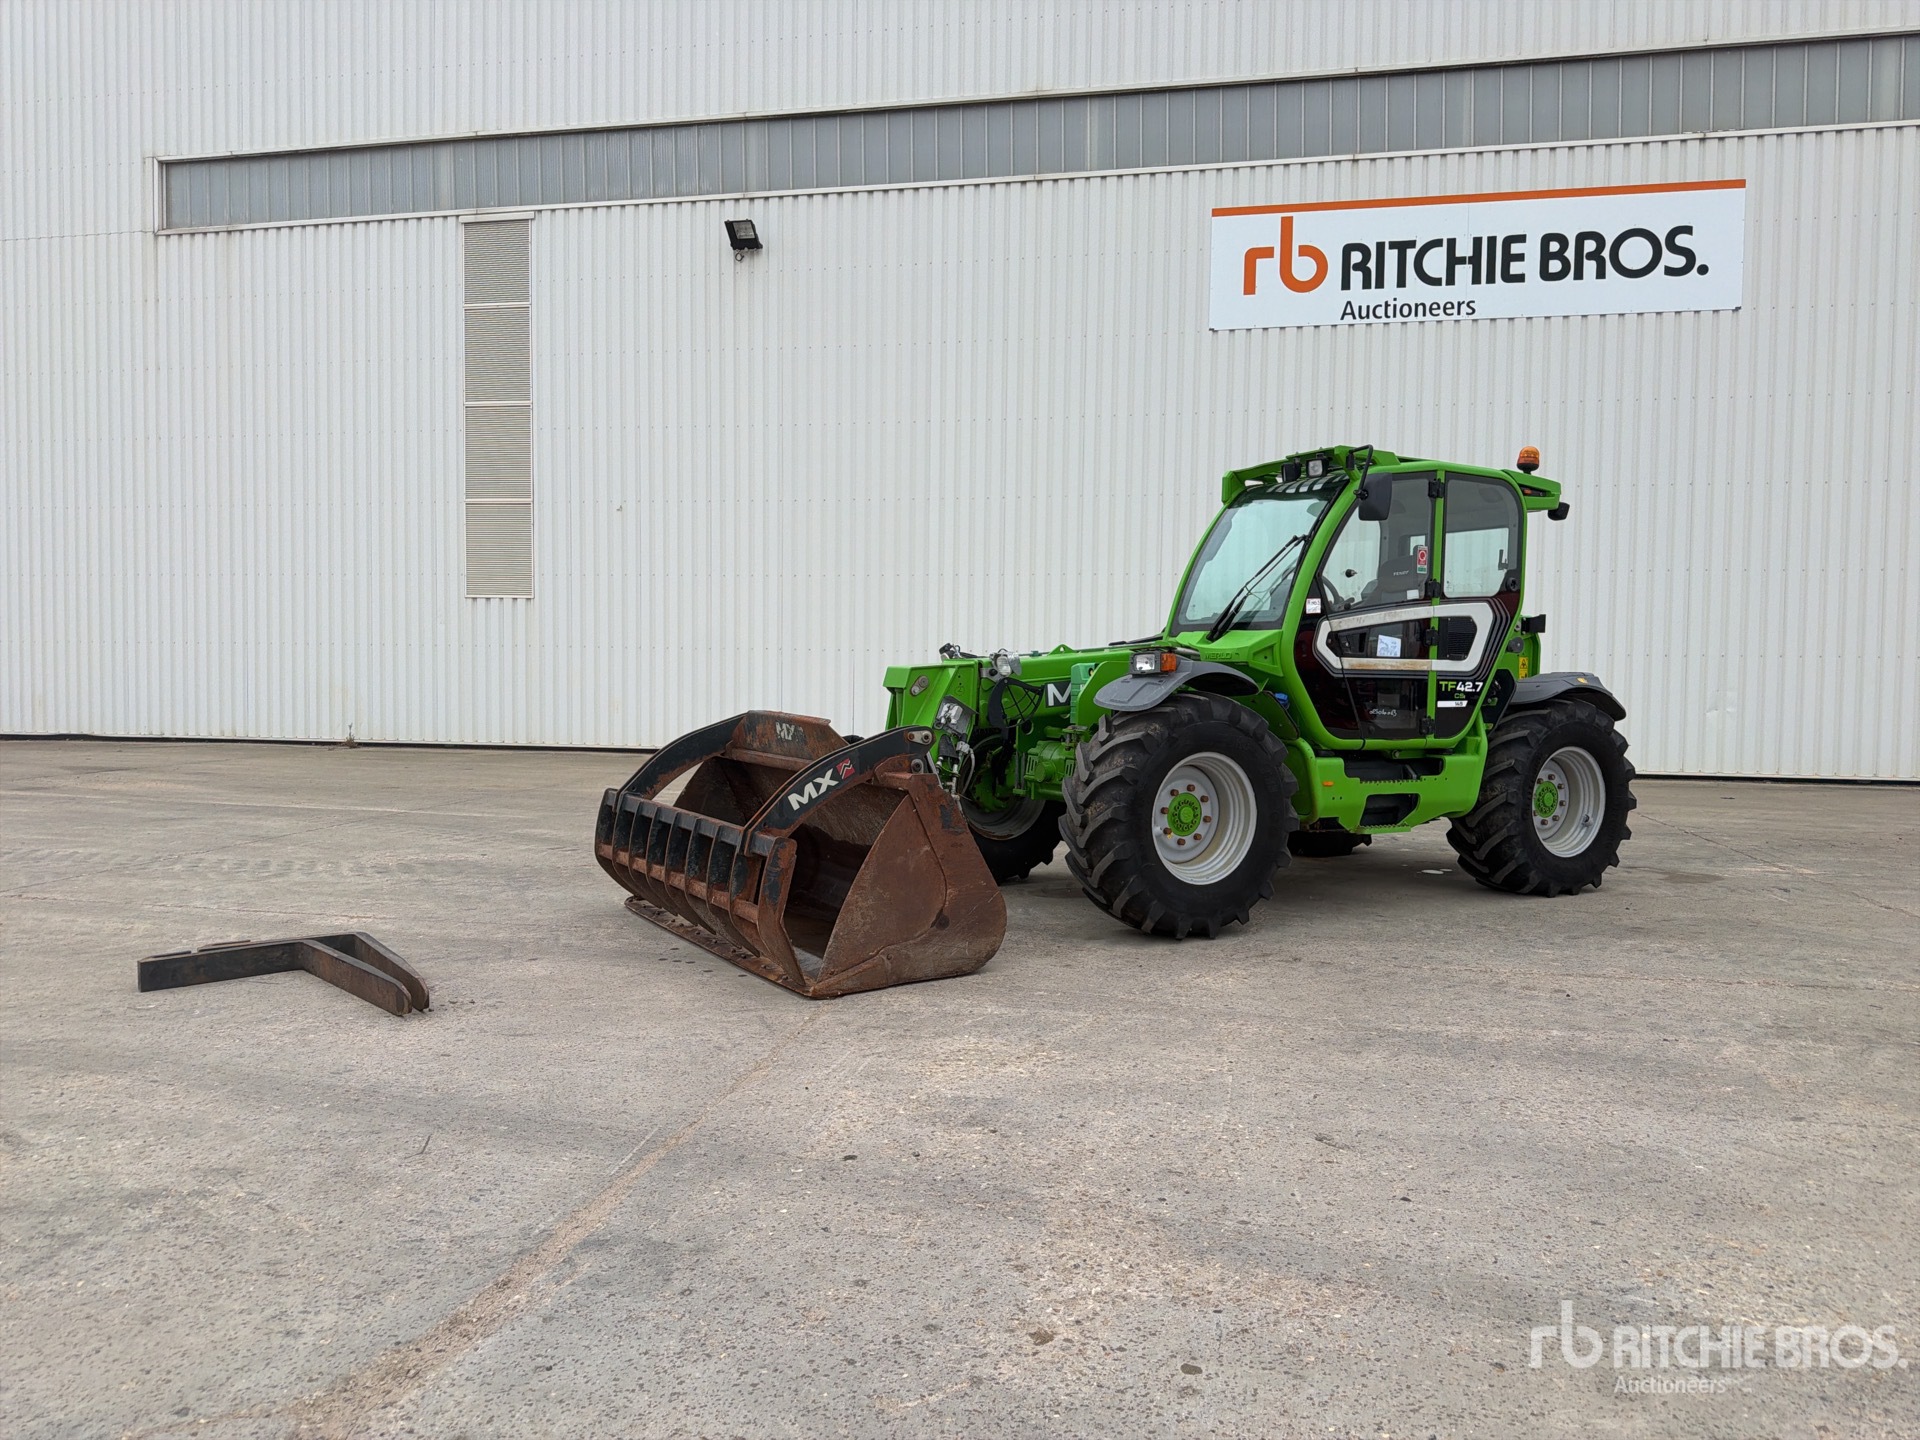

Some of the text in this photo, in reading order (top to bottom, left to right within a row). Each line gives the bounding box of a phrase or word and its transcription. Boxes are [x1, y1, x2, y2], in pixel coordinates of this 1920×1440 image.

[1340, 233, 1527, 291] RITCHIE
[1539, 225, 1709, 281] BROS.
[1340, 297, 1477, 321] Auctioneers
[787, 768, 839, 811] MX
